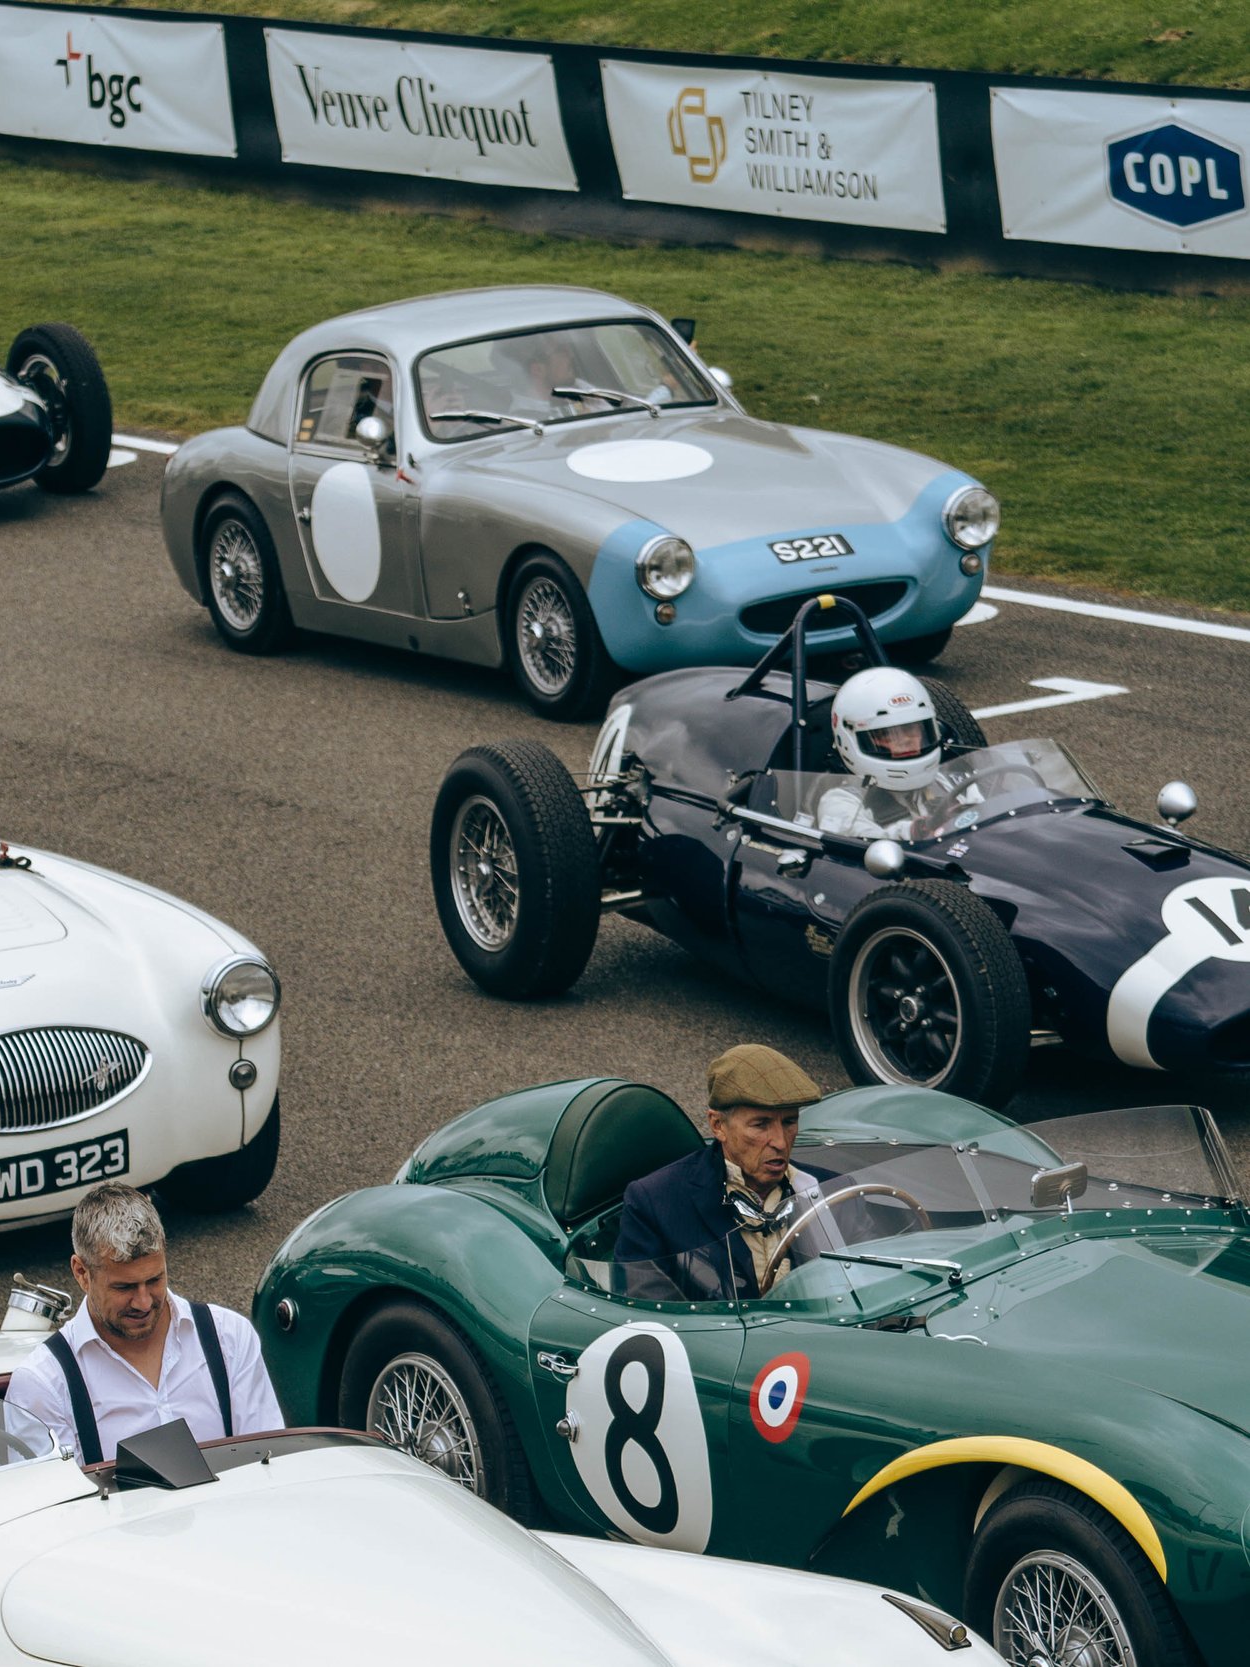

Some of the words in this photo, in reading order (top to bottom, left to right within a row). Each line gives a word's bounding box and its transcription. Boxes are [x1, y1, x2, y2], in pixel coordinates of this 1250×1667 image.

[86, 54, 141, 128] bgc
[296, 64, 391, 132] Veuve
[396, 75, 537, 156] Clicquot
[740, 91, 813, 121] TILNEY
[745, 127, 809, 159] SMITH
[817, 132, 832, 160] &
[747, 163, 878, 201] WILLIAMSON
[1123, 151, 1228, 200] COPL
[772, 535, 846, 561] S221
[55, 1137, 125, 1187] 323
[604, 1334, 679, 1534] 8
